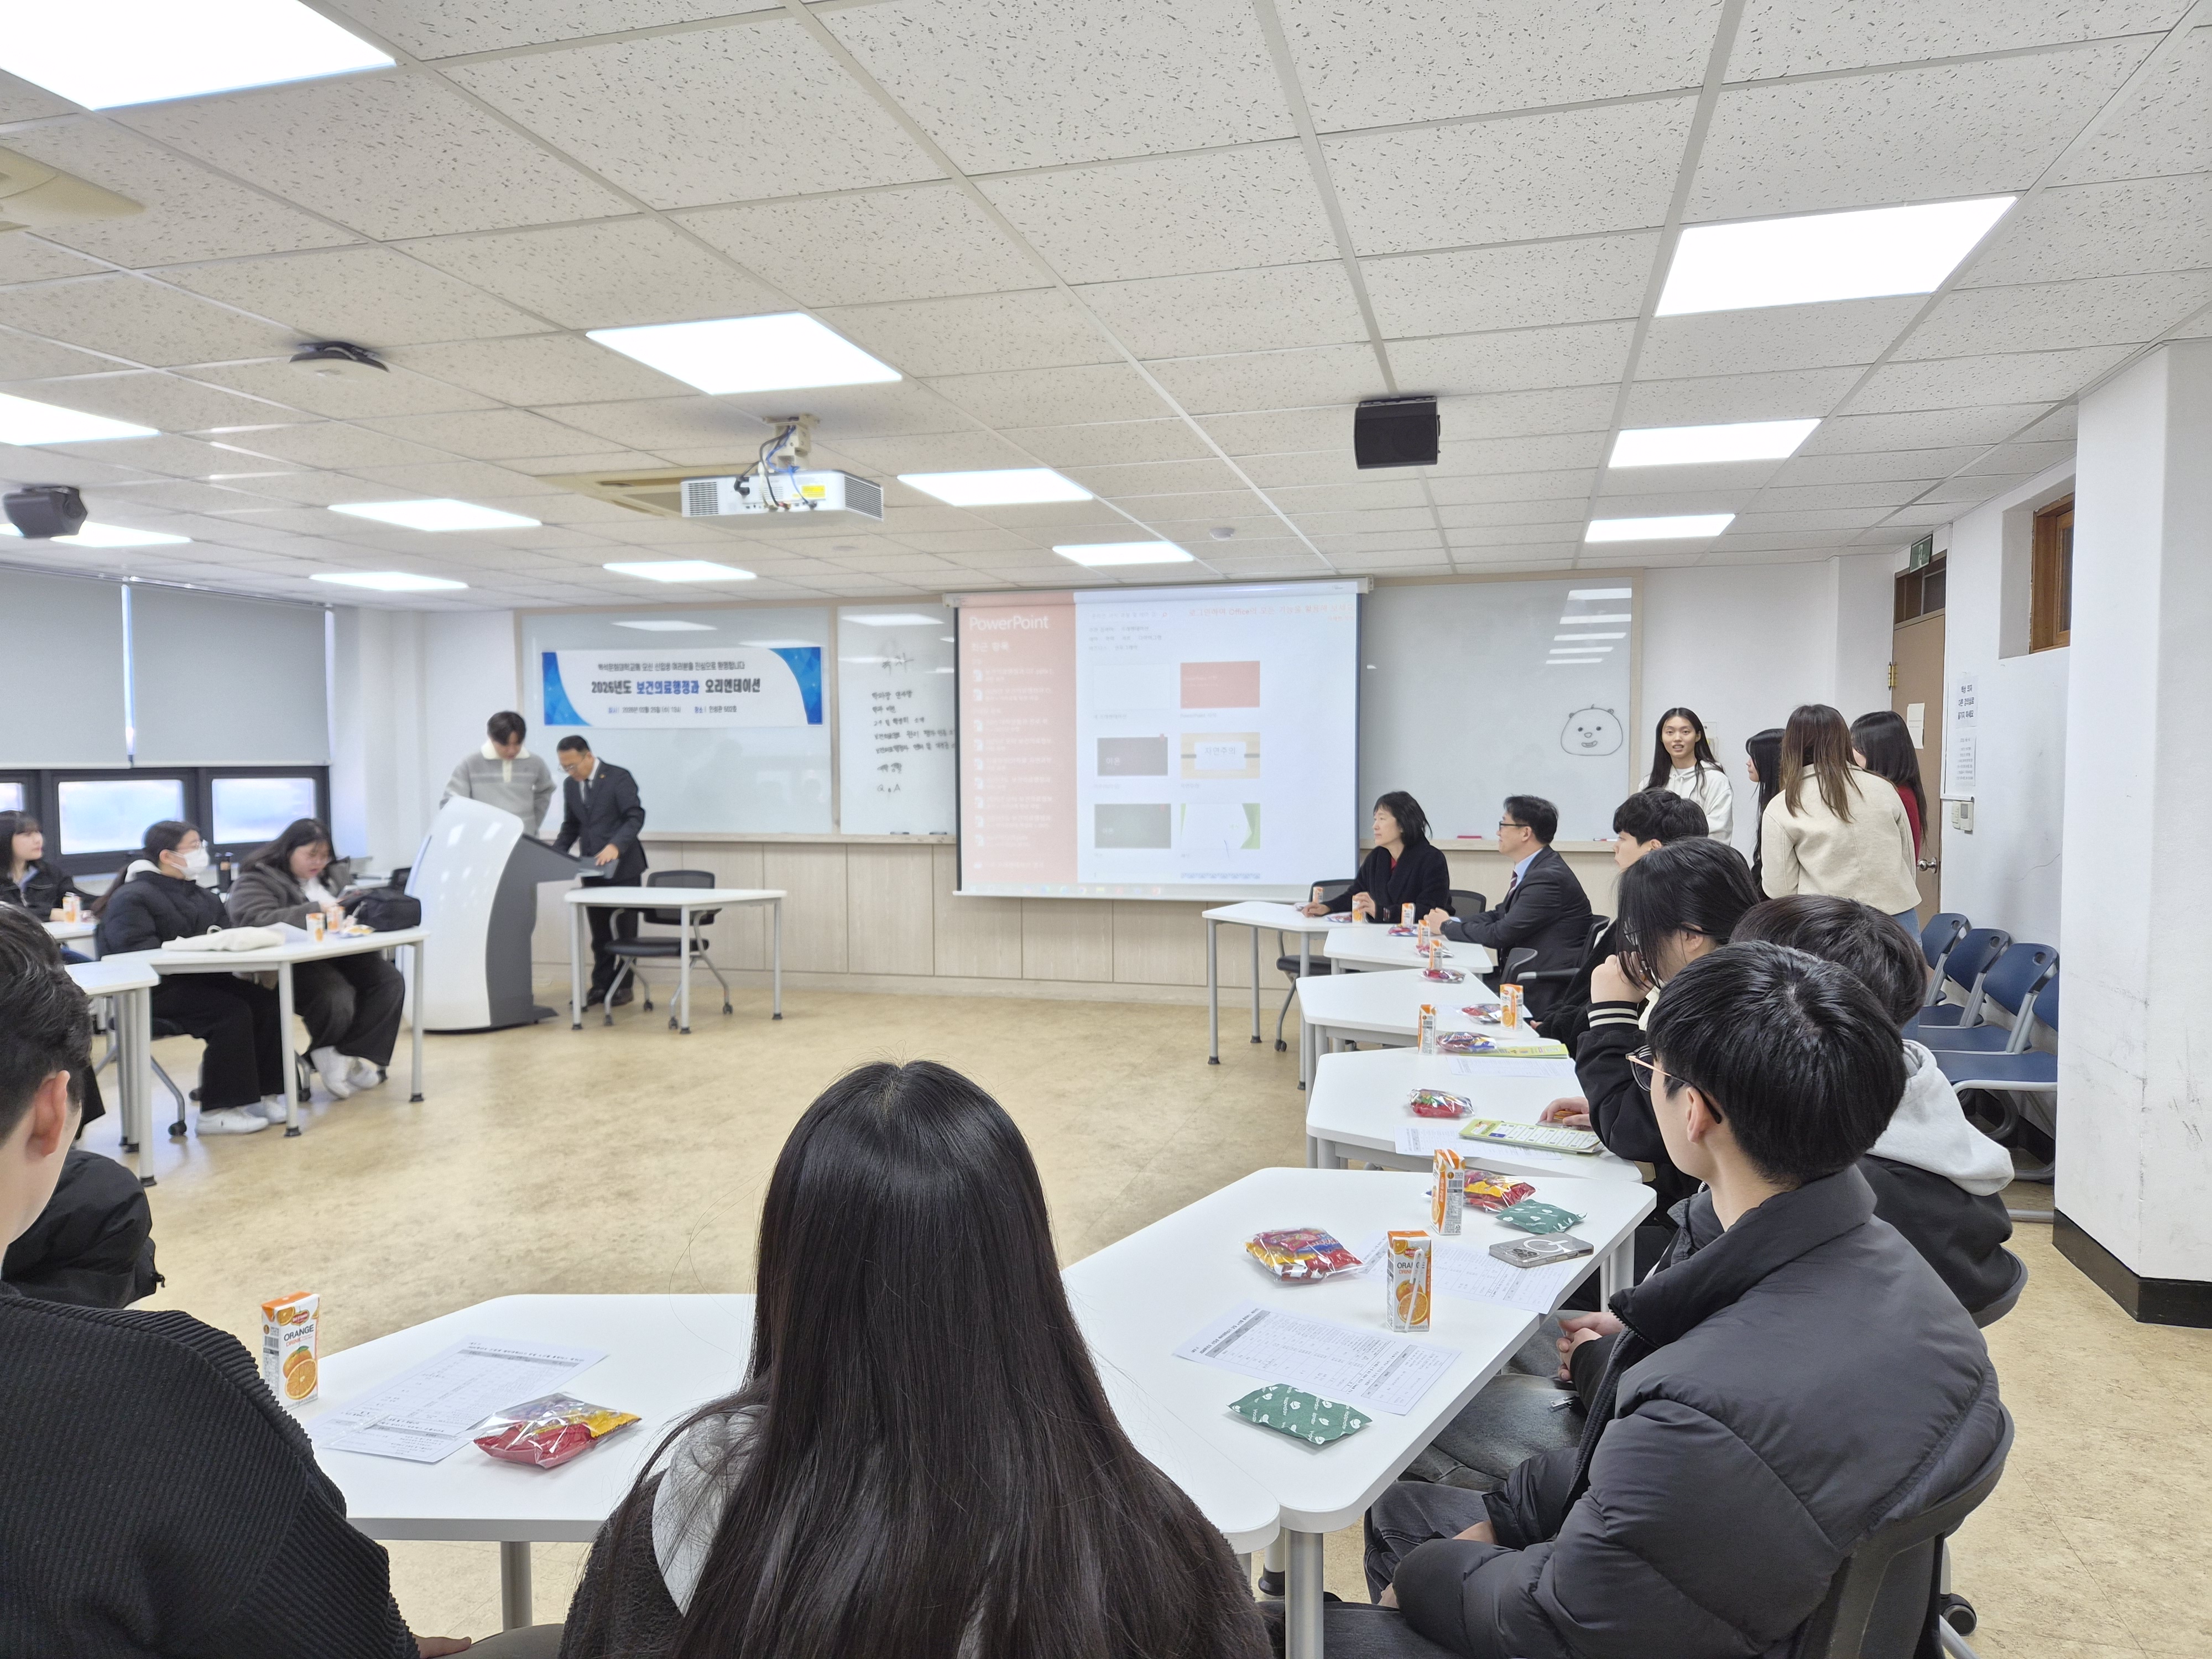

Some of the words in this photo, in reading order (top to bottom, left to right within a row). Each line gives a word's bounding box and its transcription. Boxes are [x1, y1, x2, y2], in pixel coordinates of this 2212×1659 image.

[969, 615, 1049, 630] PowerPoint
[655, 662, 671, 671] 신입생
[672, 662, 693, 671] 여러분을
[695, 662, 717, 671] 진심으로
[718, 661, 745, 670] 환영합니다
[591, 680, 632, 694] 2026년도
[637, 680, 700, 695] 보건의료행정과
[705, 678, 761, 693] 오리엔테이션
[284, 1324, 314, 1341] ORANGE
